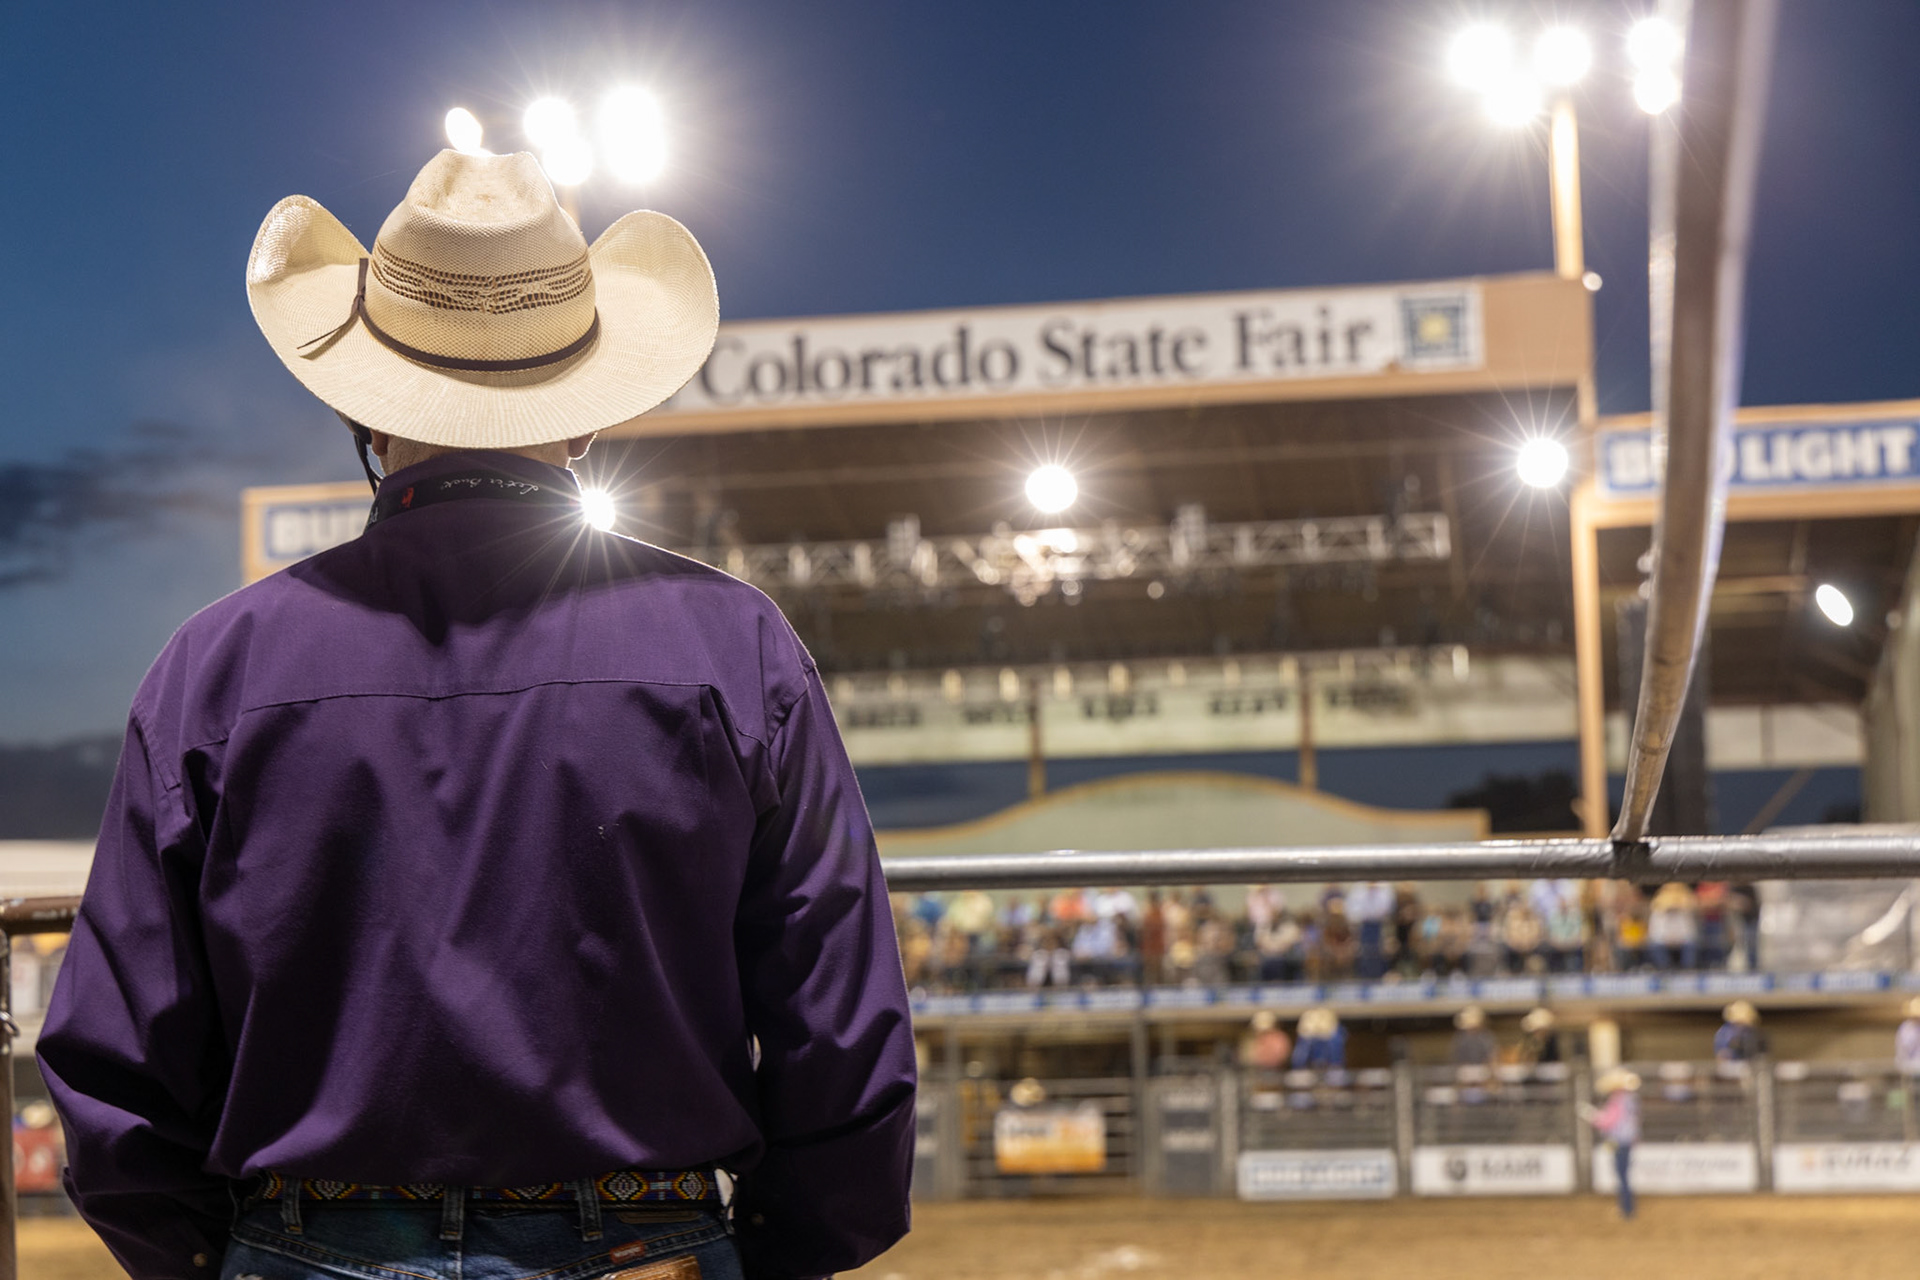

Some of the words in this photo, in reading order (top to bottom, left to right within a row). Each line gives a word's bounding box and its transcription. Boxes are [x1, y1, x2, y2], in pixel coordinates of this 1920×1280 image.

[701, 322, 1019, 400] Colorado
[1037, 315, 1208, 386] State
[1231, 303, 1375, 371] Fair
[1741, 426, 1914, 480] LIGHT
